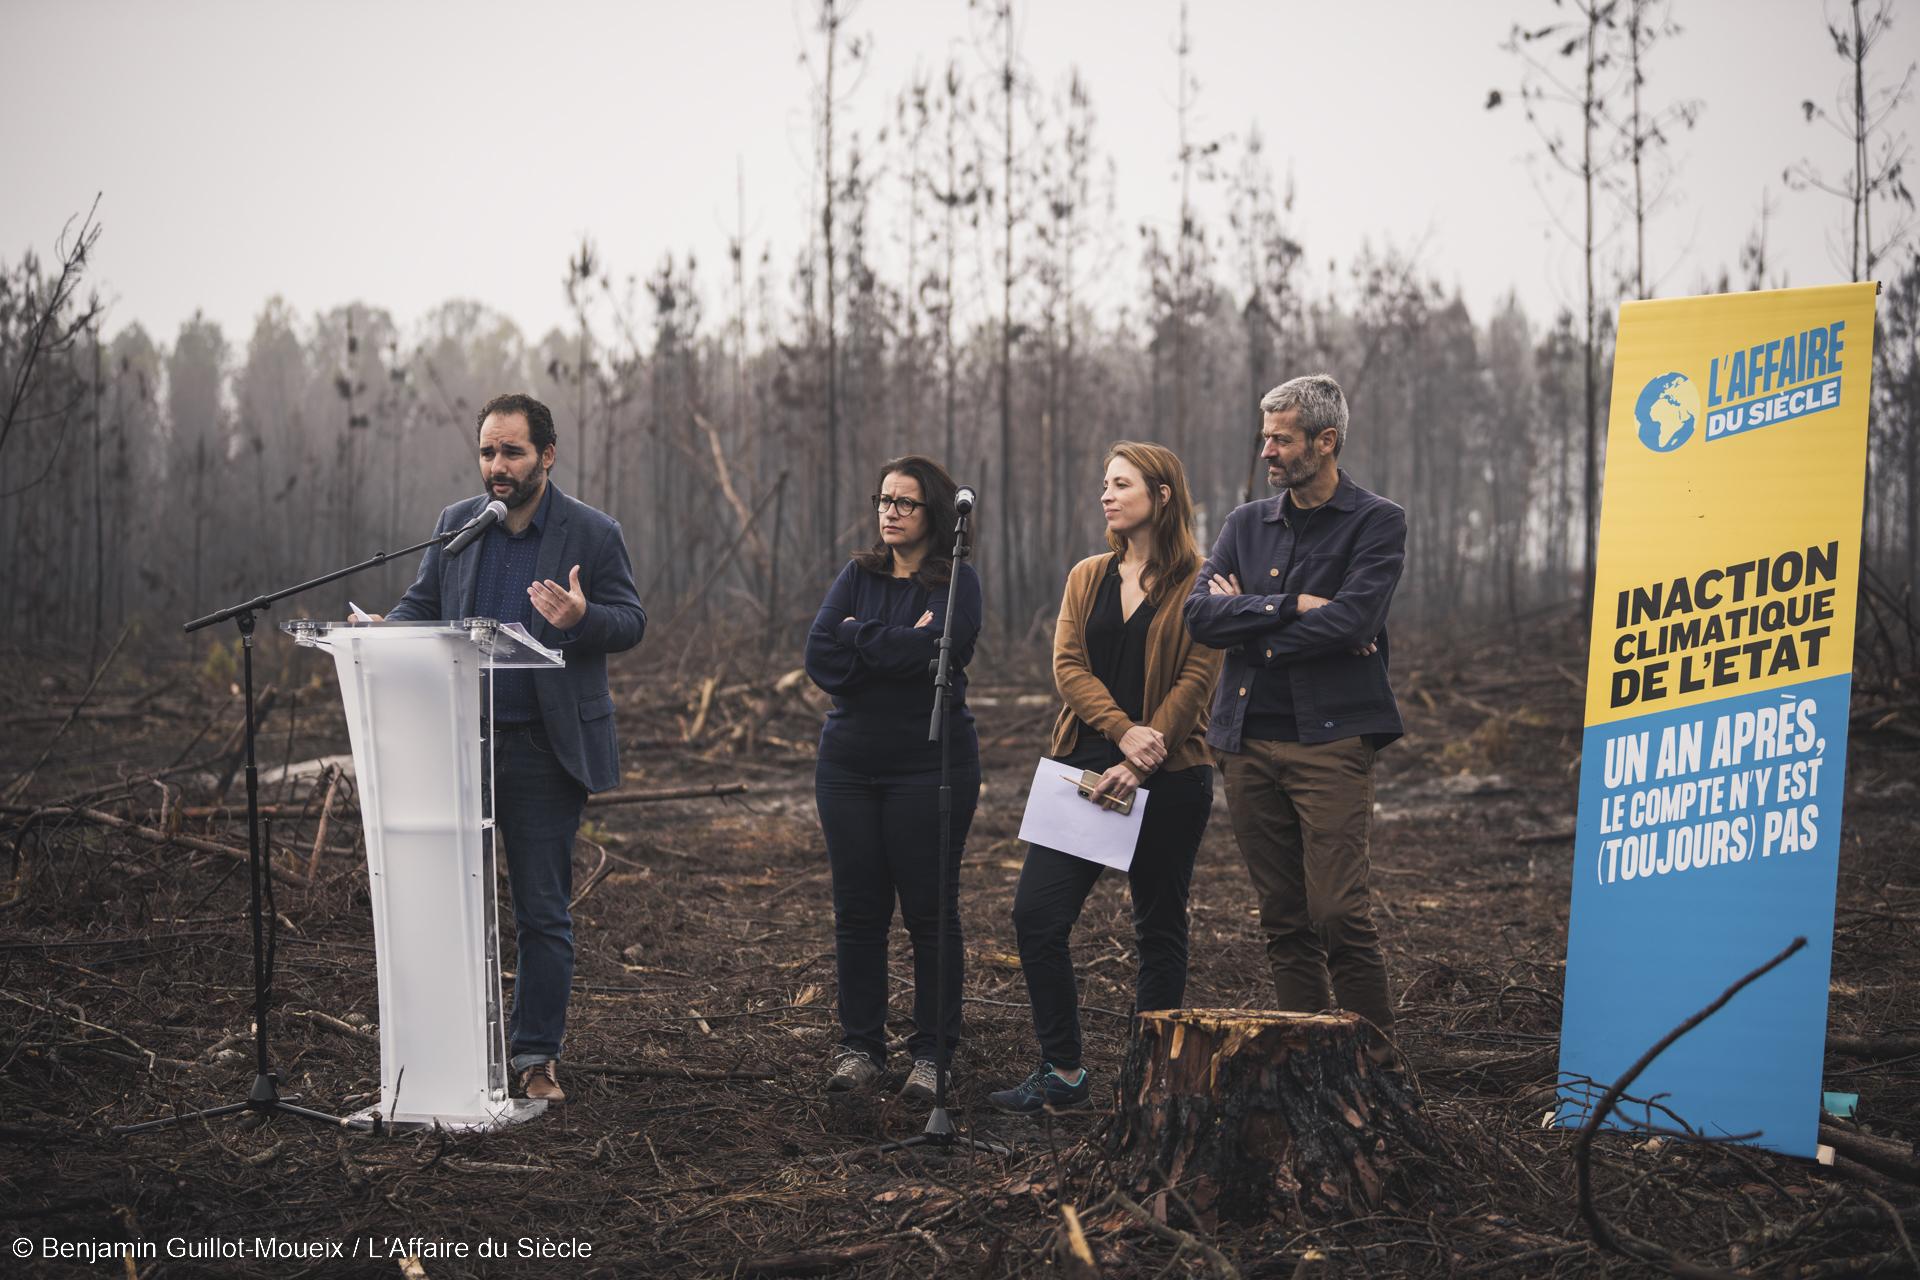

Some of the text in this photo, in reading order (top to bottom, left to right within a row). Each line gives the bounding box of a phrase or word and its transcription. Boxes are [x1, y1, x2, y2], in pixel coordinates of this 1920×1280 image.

[1708, 320, 1845, 408] L'AFFAIRE
[1708, 381, 1838, 437] DU SIÈCLE
[1613, 588, 1836, 665] CLIMATIQUE
[1616, 541, 1839, 630] INACTION
[1610, 626, 1831, 709] DE L'ETAT
[1603, 693, 1826, 789] UN AN APRÈS,
[1600, 757, 1823, 835] LE COMPTE N'Y EST
[1597, 804, 1819, 885] (TOUJOURS) PAS
